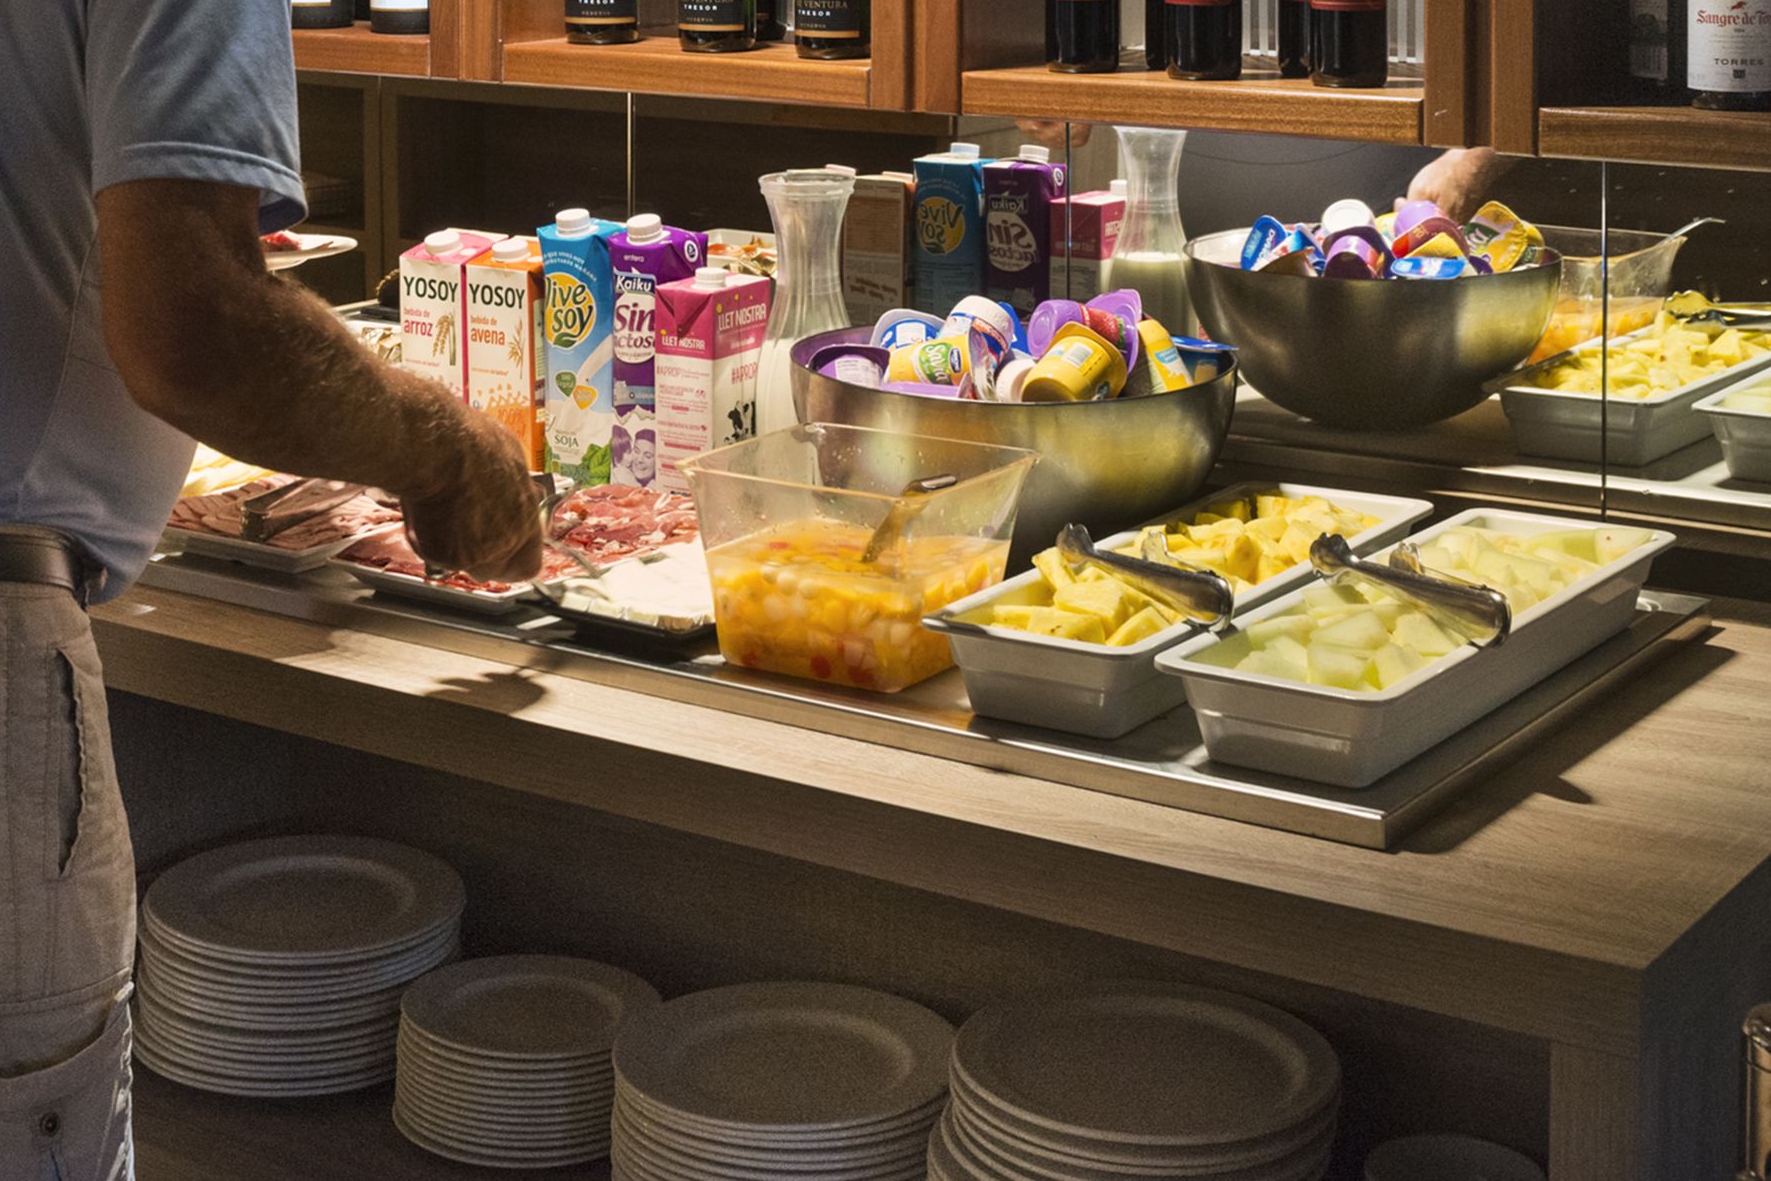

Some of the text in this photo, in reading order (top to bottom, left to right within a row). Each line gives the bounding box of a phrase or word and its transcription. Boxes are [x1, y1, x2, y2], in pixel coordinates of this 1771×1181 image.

[798, 9, 831, 17] TRESOR
[803, 0, 848, 9] VENTURA
[1696, 9, 1771, 27] Sangre de To
[1714, 58, 1764, 66] TORRES
[403, 275, 458, 303] YOSOY
[616, 275, 652, 292] Kaiku
[469, 283, 525, 309] YOSOY
[423, 310, 431, 318] de
[490, 317, 498, 326] de
[552, 305, 593, 336] soy
[615, 303, 655, 333] Sin
[735, 303, 767, 325] NOSTRA
[403, 320, 433, 337] arroz
[470, 327, 505, 345] avena
[661, 335, 706, 350] LLET NOSTRA
[554, 434, 580, 447] SOJA
